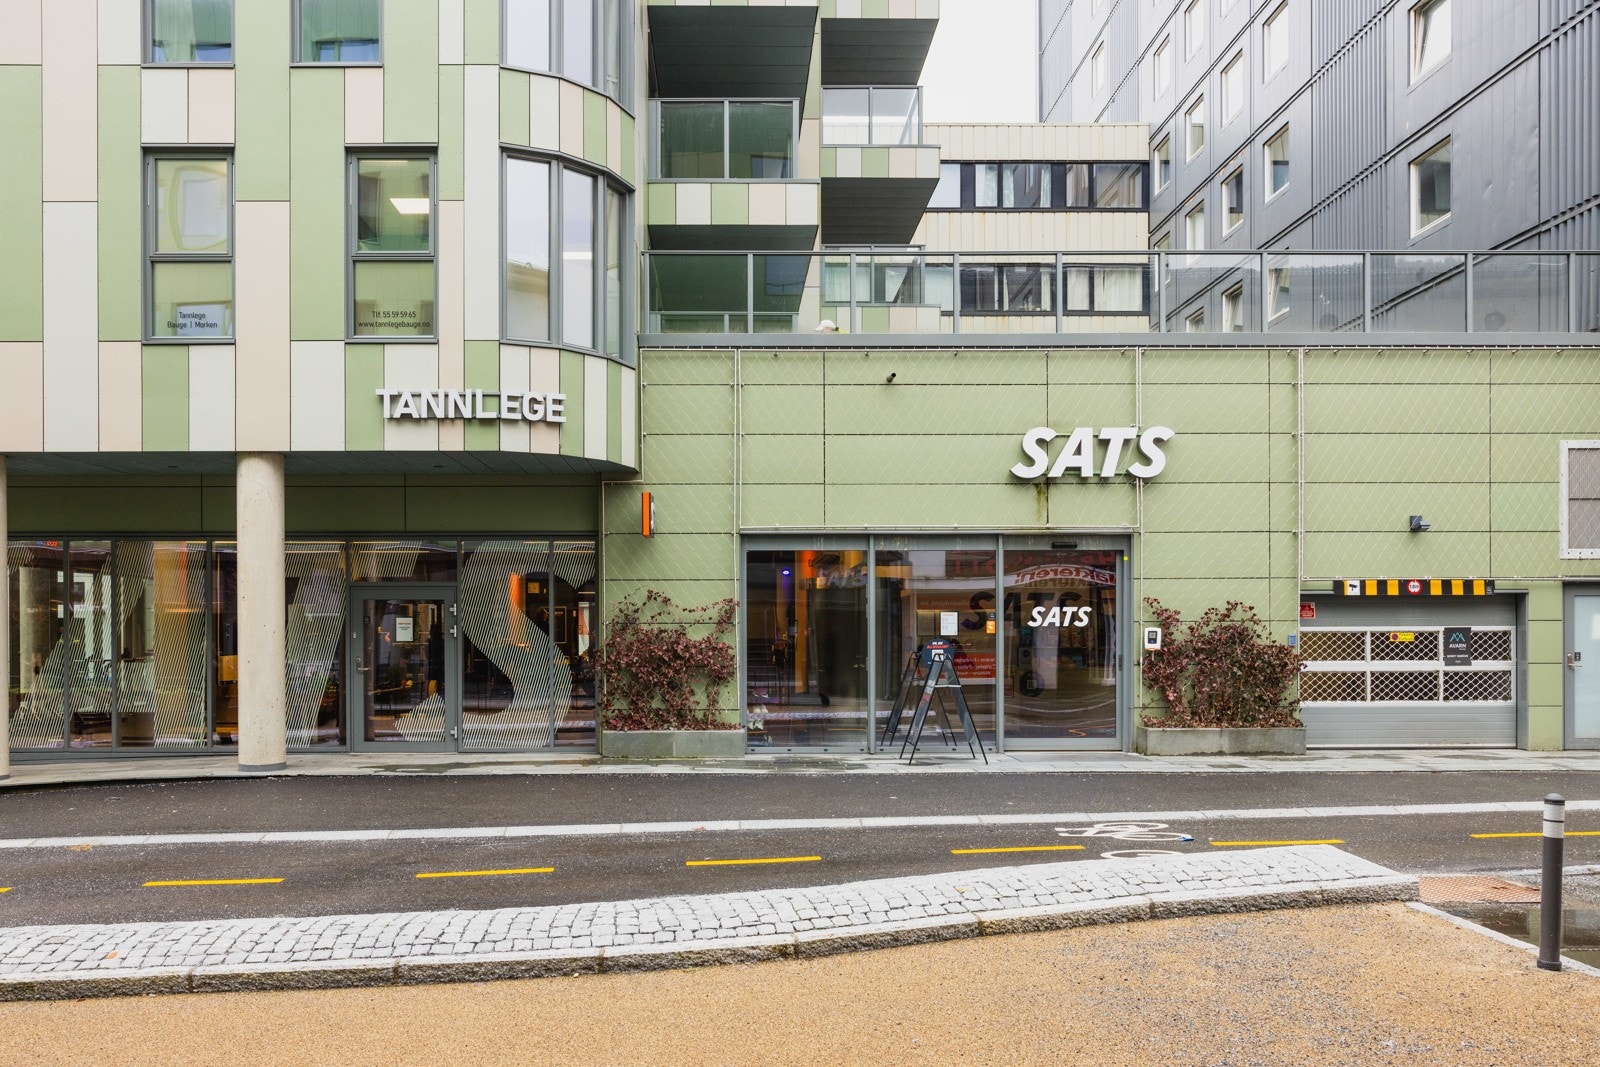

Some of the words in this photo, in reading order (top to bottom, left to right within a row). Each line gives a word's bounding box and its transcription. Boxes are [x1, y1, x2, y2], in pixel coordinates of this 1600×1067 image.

[178, 312, 206, 321] Tannlege
[383, 310, 391, 319] 55
[392, 310, 400, 319] 59
[401, 310, 408, 319] 59
[408, 310, 417, 319] 65
[167, 321, 188, 330] Bauge
[195, 321, 218, 329] Morken
[357, 320, 431, 330] www.tannlegebauge.no
[375, 388, 567, 423] TANNLEGE
[1009, 426, 1176, 479] SATS
[1027, 606, 1092, 628] SATS
